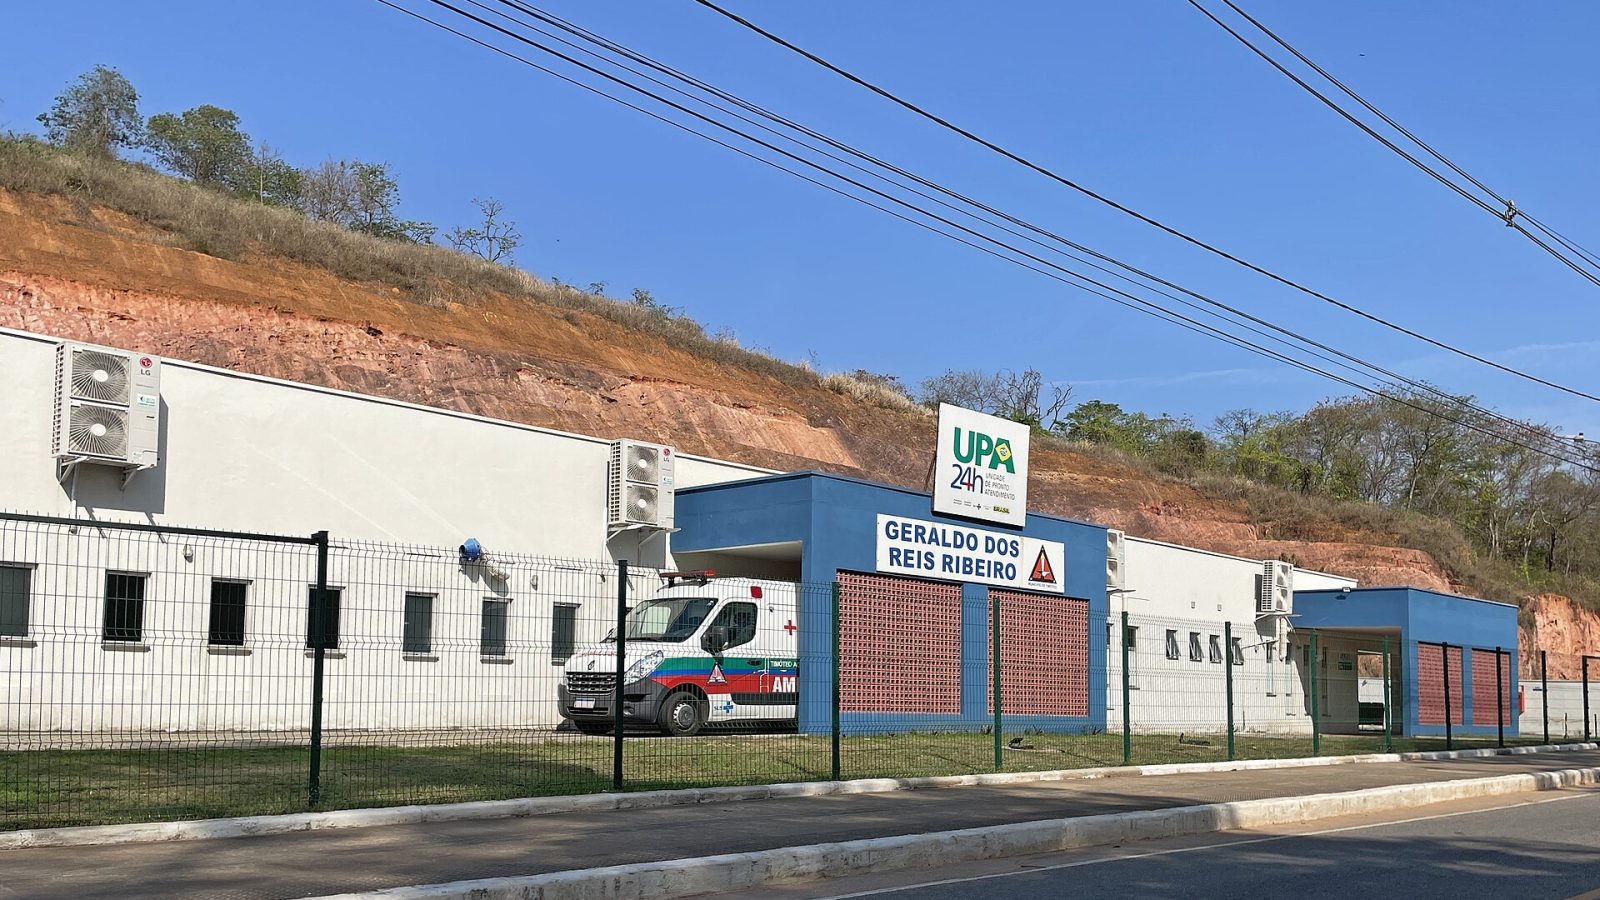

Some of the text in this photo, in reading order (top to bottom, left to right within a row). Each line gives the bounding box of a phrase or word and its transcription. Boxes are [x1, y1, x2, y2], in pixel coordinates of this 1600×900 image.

[140, 368, 151, 376] LG
[953, 426, 1016, 475] UPA
[950, 464, 984, 494] 24h
[985, 472, 1006, 483] UNIDADE
[985, 480, 1010, 492] DE PRONTO
[984, 488, 1016, 501] ATENDIMENTO
[885, 520, 1020, 558] GERALDO DOS
[888, 547, 1017, 581] REIS RIBEIRO
